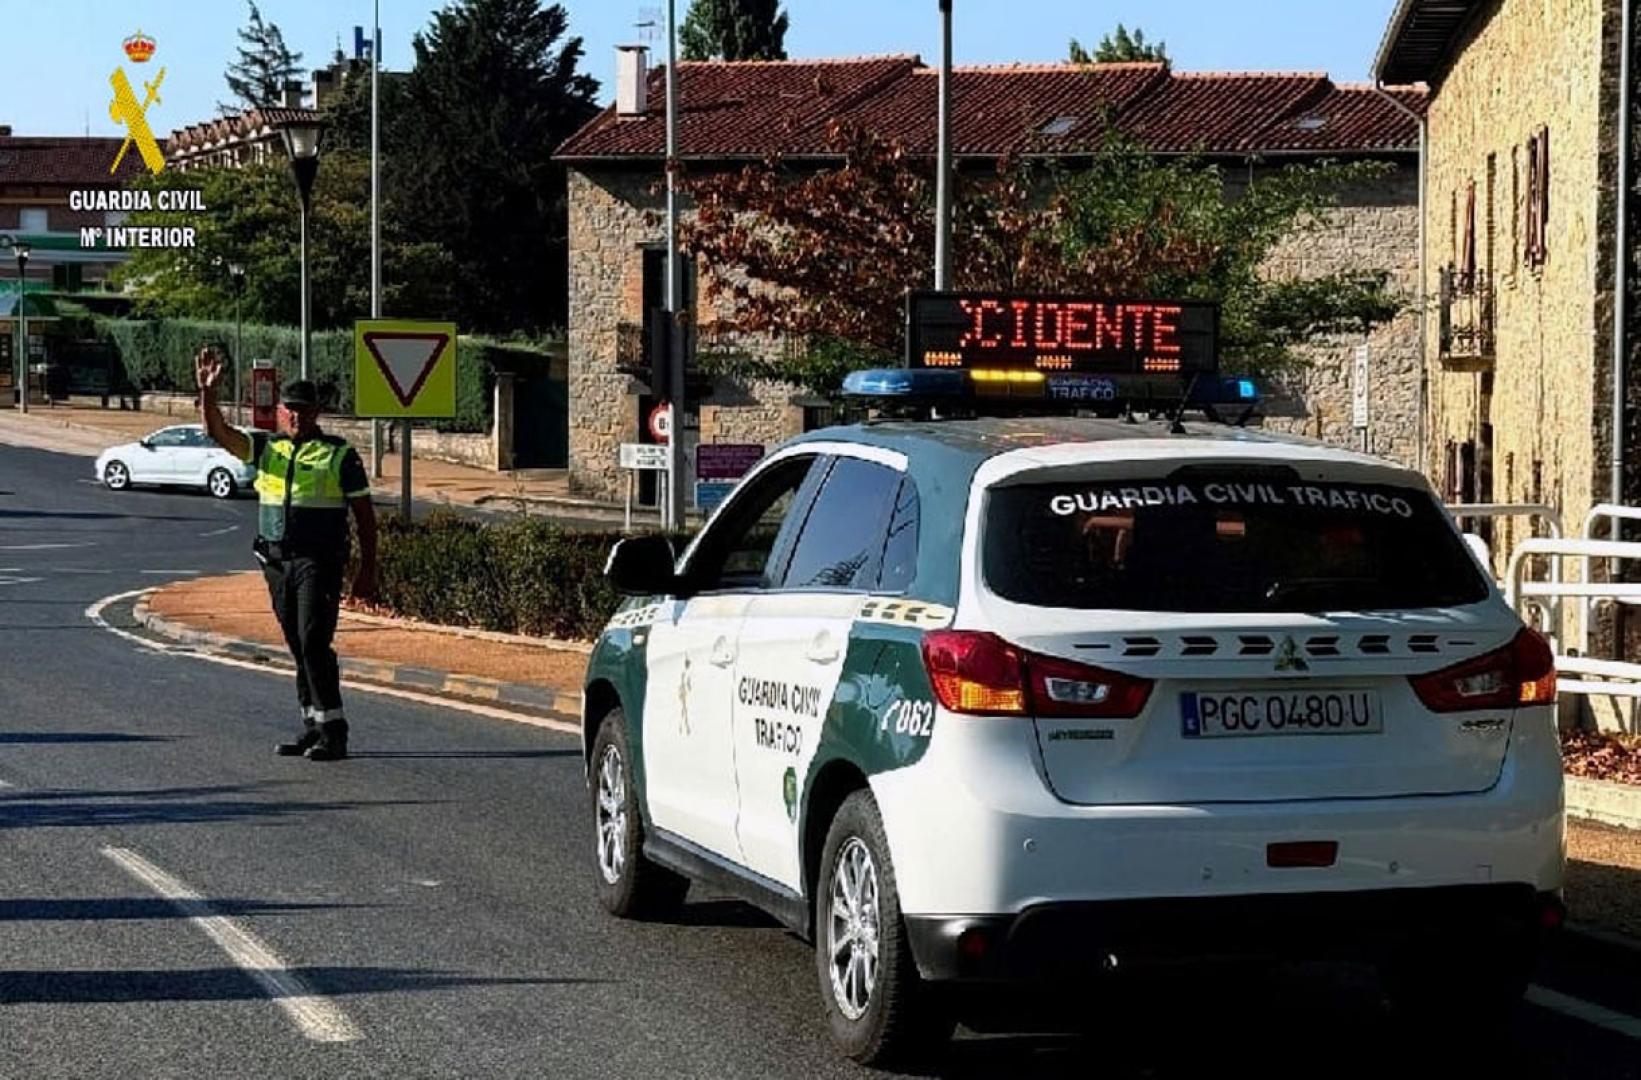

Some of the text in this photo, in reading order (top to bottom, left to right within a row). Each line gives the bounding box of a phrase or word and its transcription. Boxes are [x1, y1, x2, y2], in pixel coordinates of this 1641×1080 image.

[1050, 483, 1413, 518] GUARDIA CIVIL TRAFICO
[738, 677, 788, 711] GUARDIA
[896, 699, 932, 737] 062
[1200, 696, 1260, 731] PGC
[1266, 694, 1344, 730] 0480
